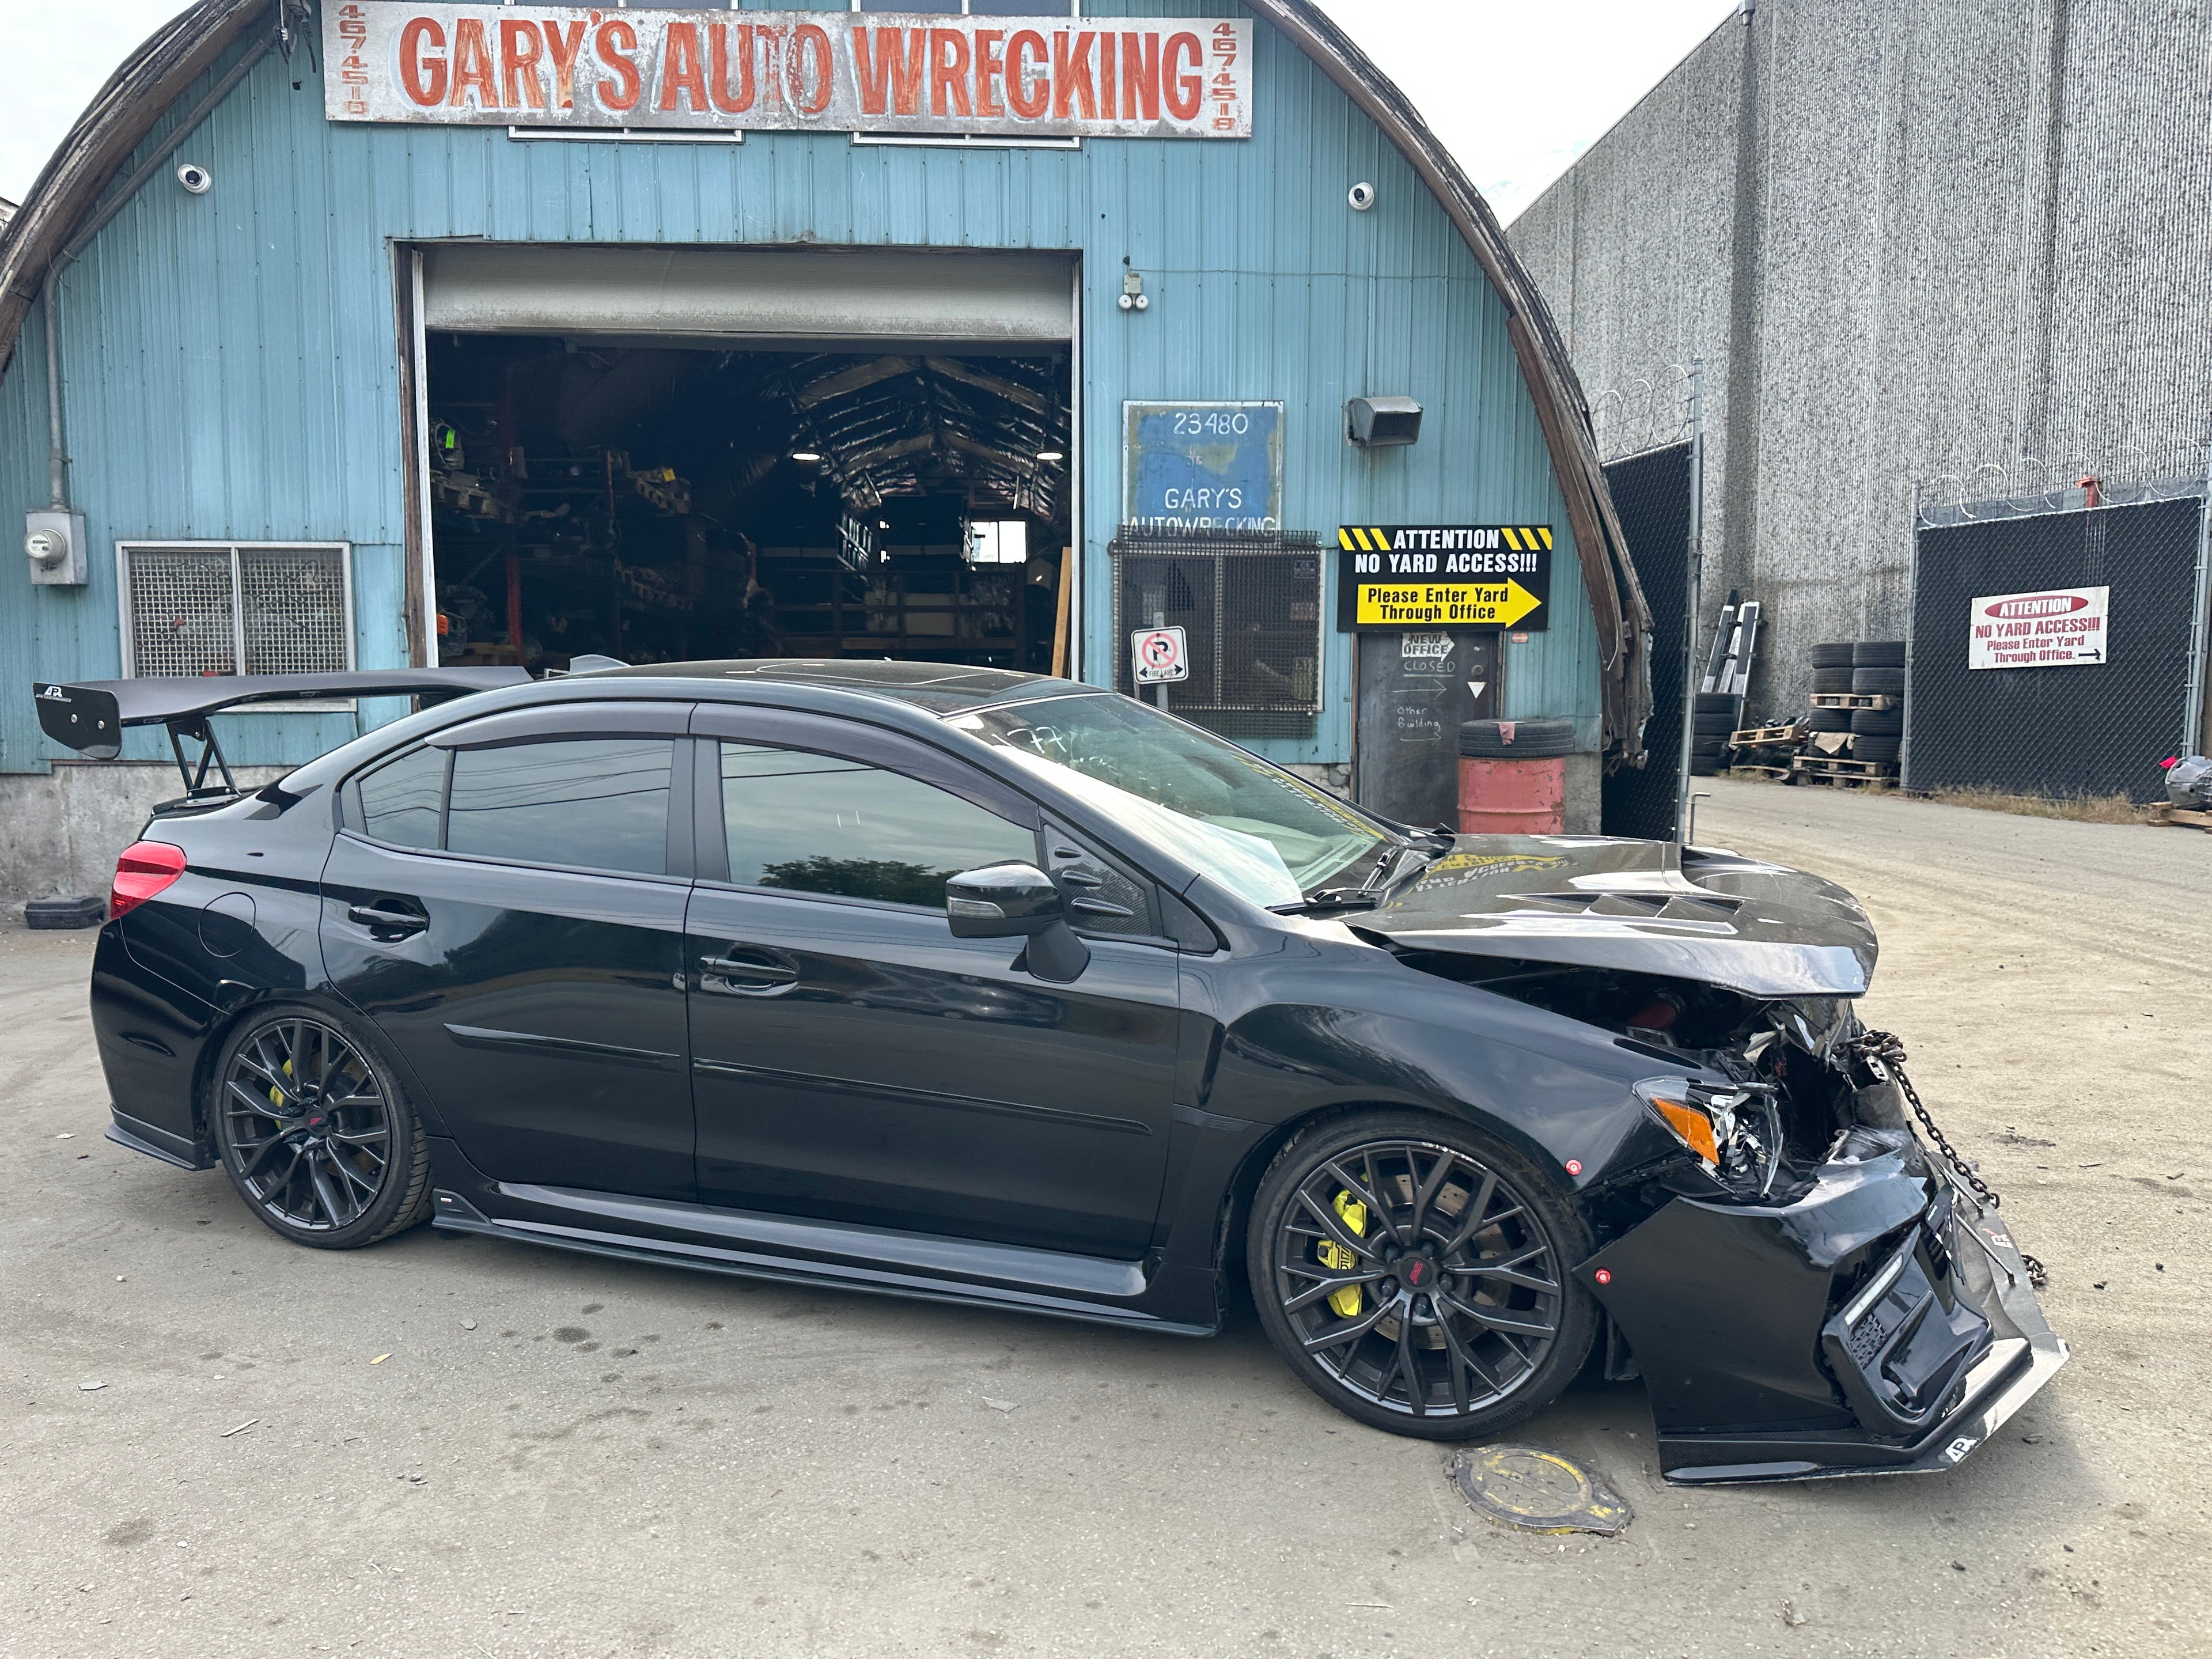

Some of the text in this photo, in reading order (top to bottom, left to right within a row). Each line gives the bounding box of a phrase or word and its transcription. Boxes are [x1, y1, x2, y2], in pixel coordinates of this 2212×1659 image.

[399, 11, 1203, 122] GARY'S AUTO WRECKING
[1173, 412, 1249, 435] 23480
[1165, 488, 1243, 509] GARY'S
[1393, 529, 1499, 550] ATTENTION
[1355, 553, 1537, 574] NO YARD ACCESS!!!
[1368, 587, 1509, 603] Please Enter Yard
[1380, 604, 1495, 622] Through Office
[1999, 597, 2072, 617] ATTENTION
[1975, 617, 2100, 639] NO YARD ACCESS!!!
[1410, 634, 1442, 644] NEW
[1987, 635, 2085, 651] Please Enter Yard
[1403, 643, 1448, 655] OFFICE
[1994, 651, 2036, 664] Through
[1161, 669, 1174, 677] LANE
[1404, 660, 1456, 672] CLOSED
[1397, 706, 1429, 714] Other
[1397, 717, 1441, 733] Building
